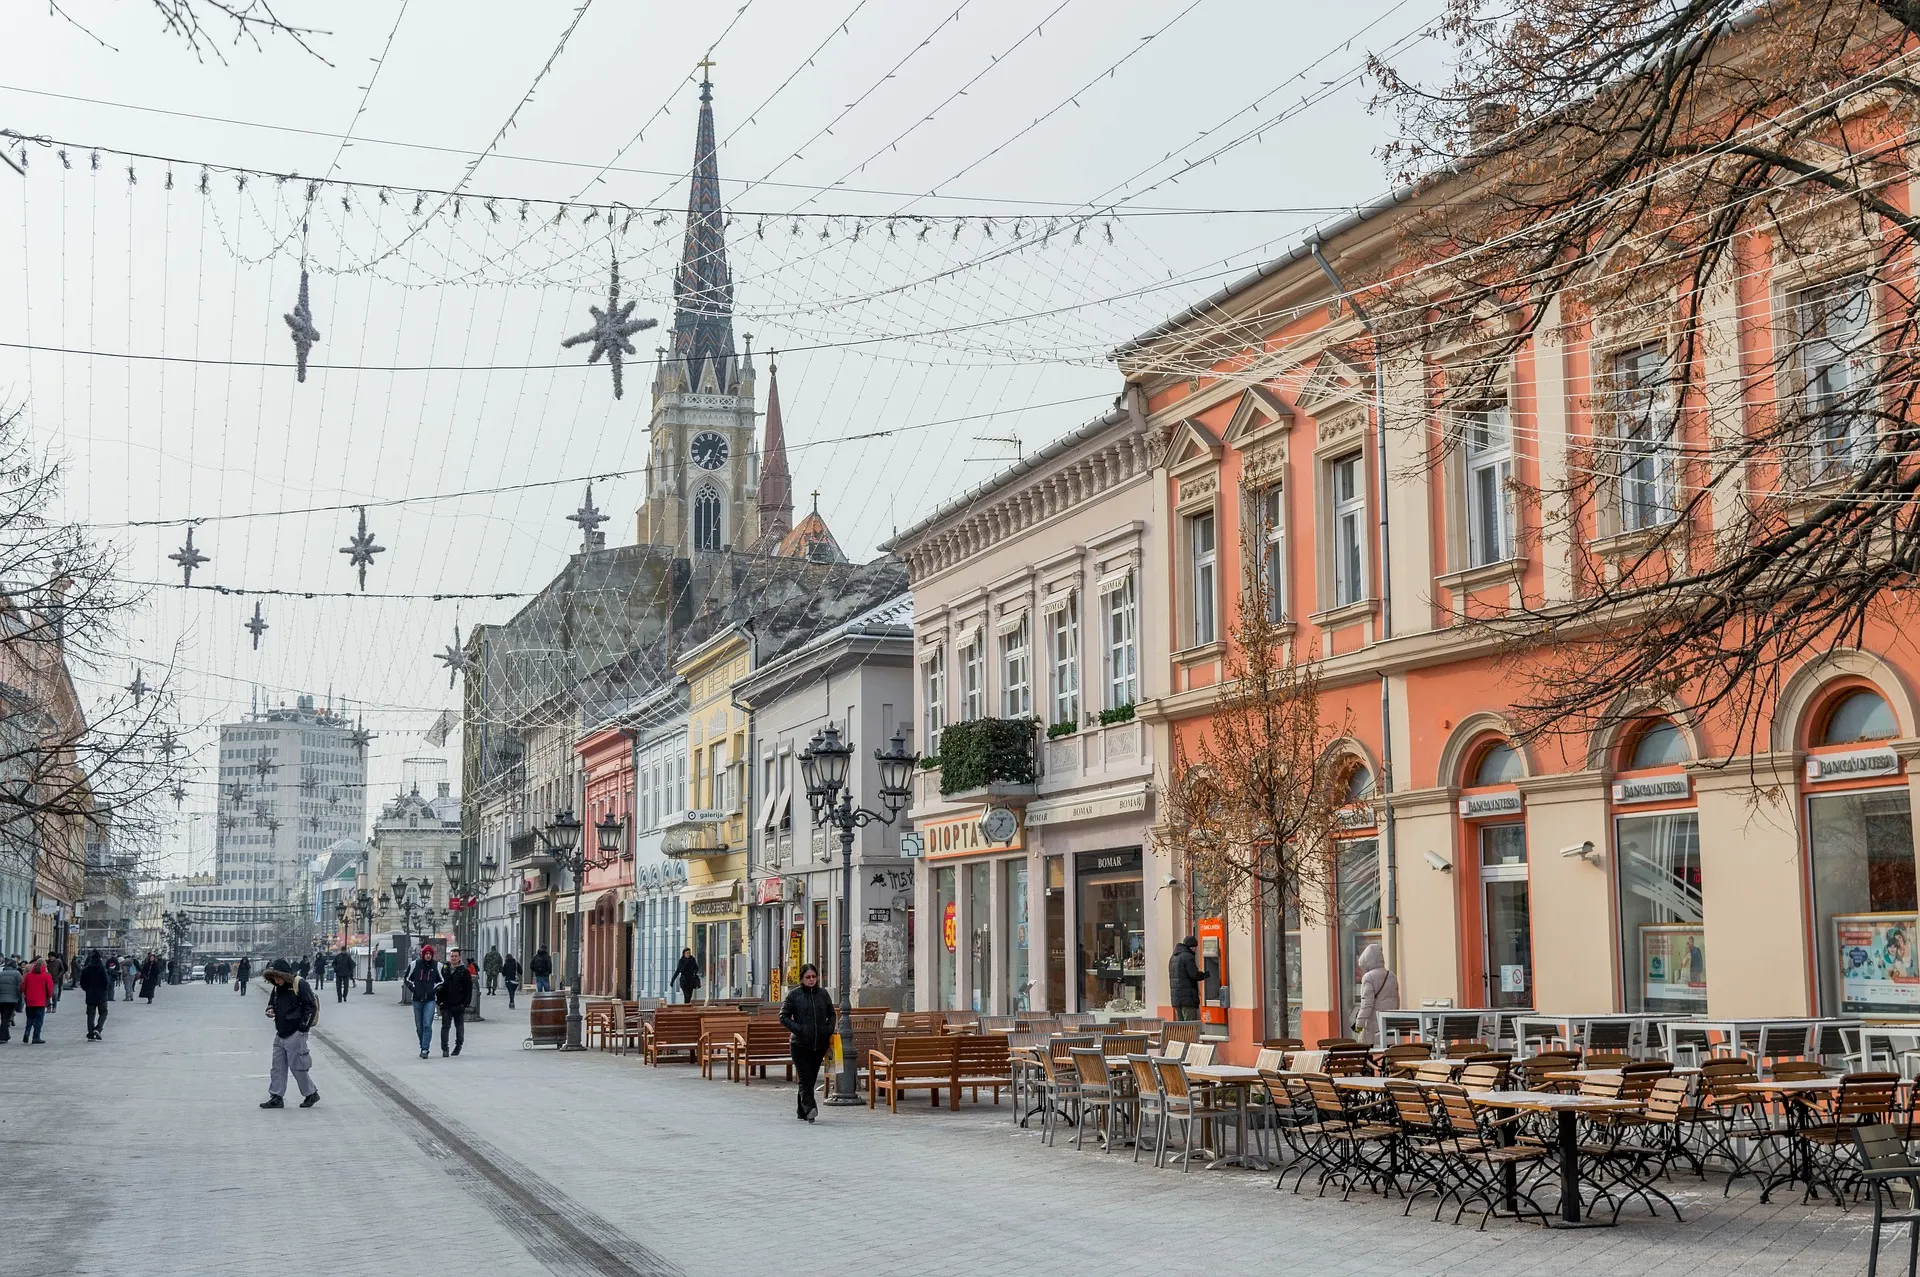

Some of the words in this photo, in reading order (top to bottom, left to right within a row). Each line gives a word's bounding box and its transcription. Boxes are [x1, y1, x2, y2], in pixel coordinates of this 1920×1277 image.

[1119, 798, 1141, 810] BOMAR
[1073, 805, 1093, 816] BOMAR
[1029, 813, 1048, 823] BOMAR
[929, 821, 979, 853] DIOPTA
[1098, 856, 1122, 868] BOMAR
